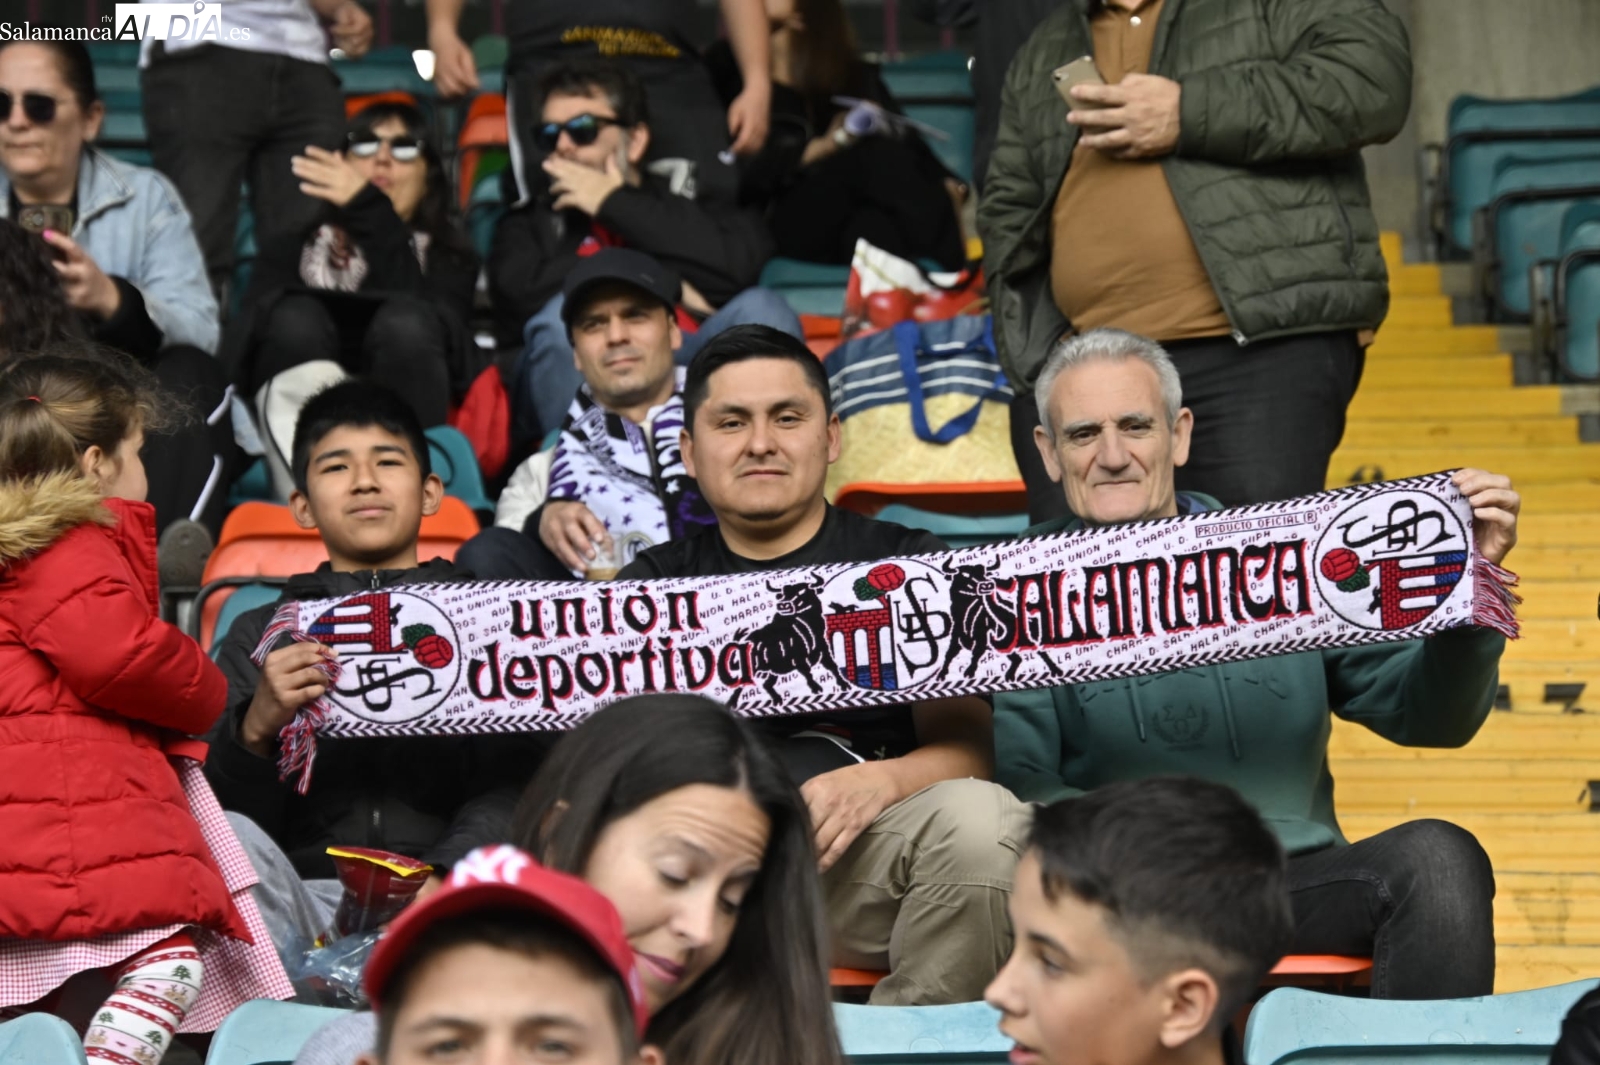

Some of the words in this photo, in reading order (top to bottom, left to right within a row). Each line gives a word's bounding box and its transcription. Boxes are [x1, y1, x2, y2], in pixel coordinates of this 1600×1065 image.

[1135, 522, 1187, 549] CHARROS
[1197, 521, 1252, 536] PRODUCTO
[1257, 515, 1301, 529] OFICIAL
[1067, 544, 1101, 563] UNION
[467, 596, 501, 612] UNION
[731, 590, 761, 607] HALA
[986, 537, 1315, 655] SALAMANCA
[723, 599, 774, 626] CHARROS
[1190, 633, 1220, 653] HALA
[467, 635, 757, 714] deportiva
[445, 700, 475, 718] HALA
